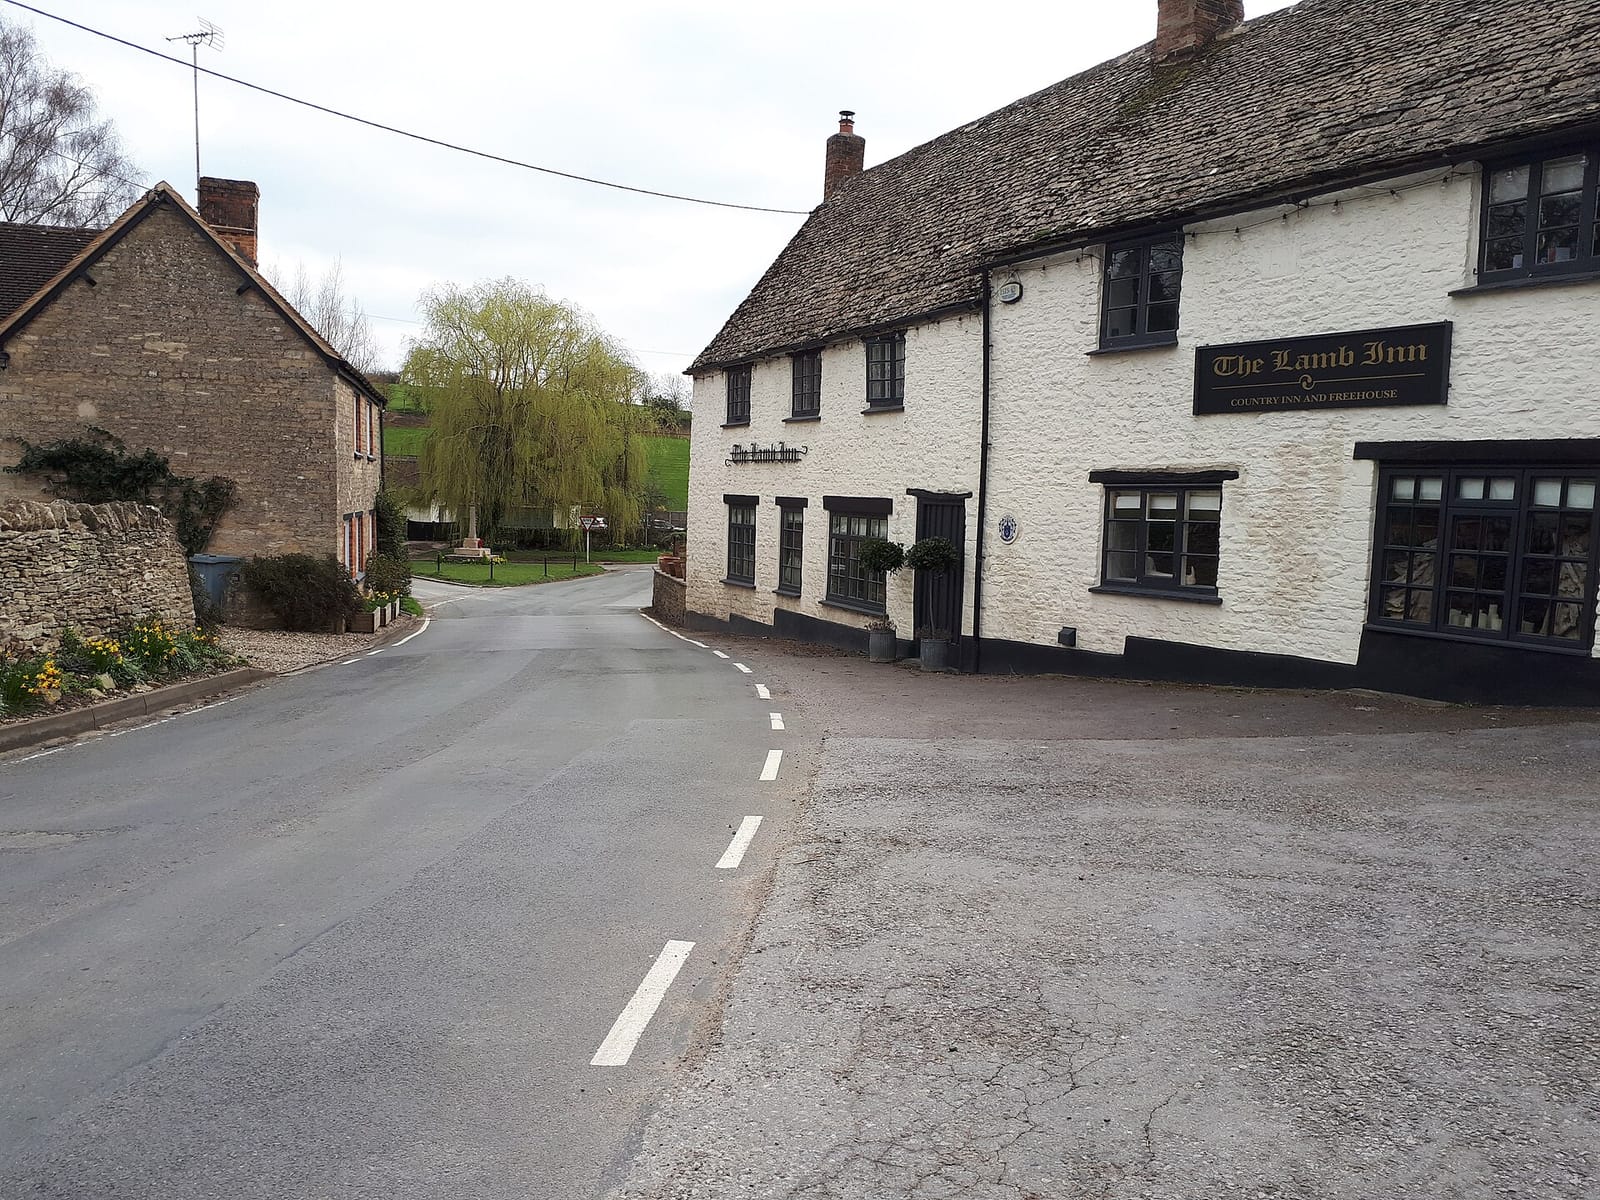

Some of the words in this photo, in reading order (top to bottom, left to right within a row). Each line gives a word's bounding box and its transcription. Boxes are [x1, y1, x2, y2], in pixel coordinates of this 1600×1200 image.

[1213, 355, 1264, 378] The
[1271, 346, 1354, 372] Lamb
[1360, 341, 1428, 365] Inn
[1231, 396, 1280, 407] COUNTRY
[1280, 395, 1301, 404] INN
[1303, 393, 1327, 403] AND
[1329, 389, 1398, 401] FREEHOUSE
[731, 444, 749, 466] The
